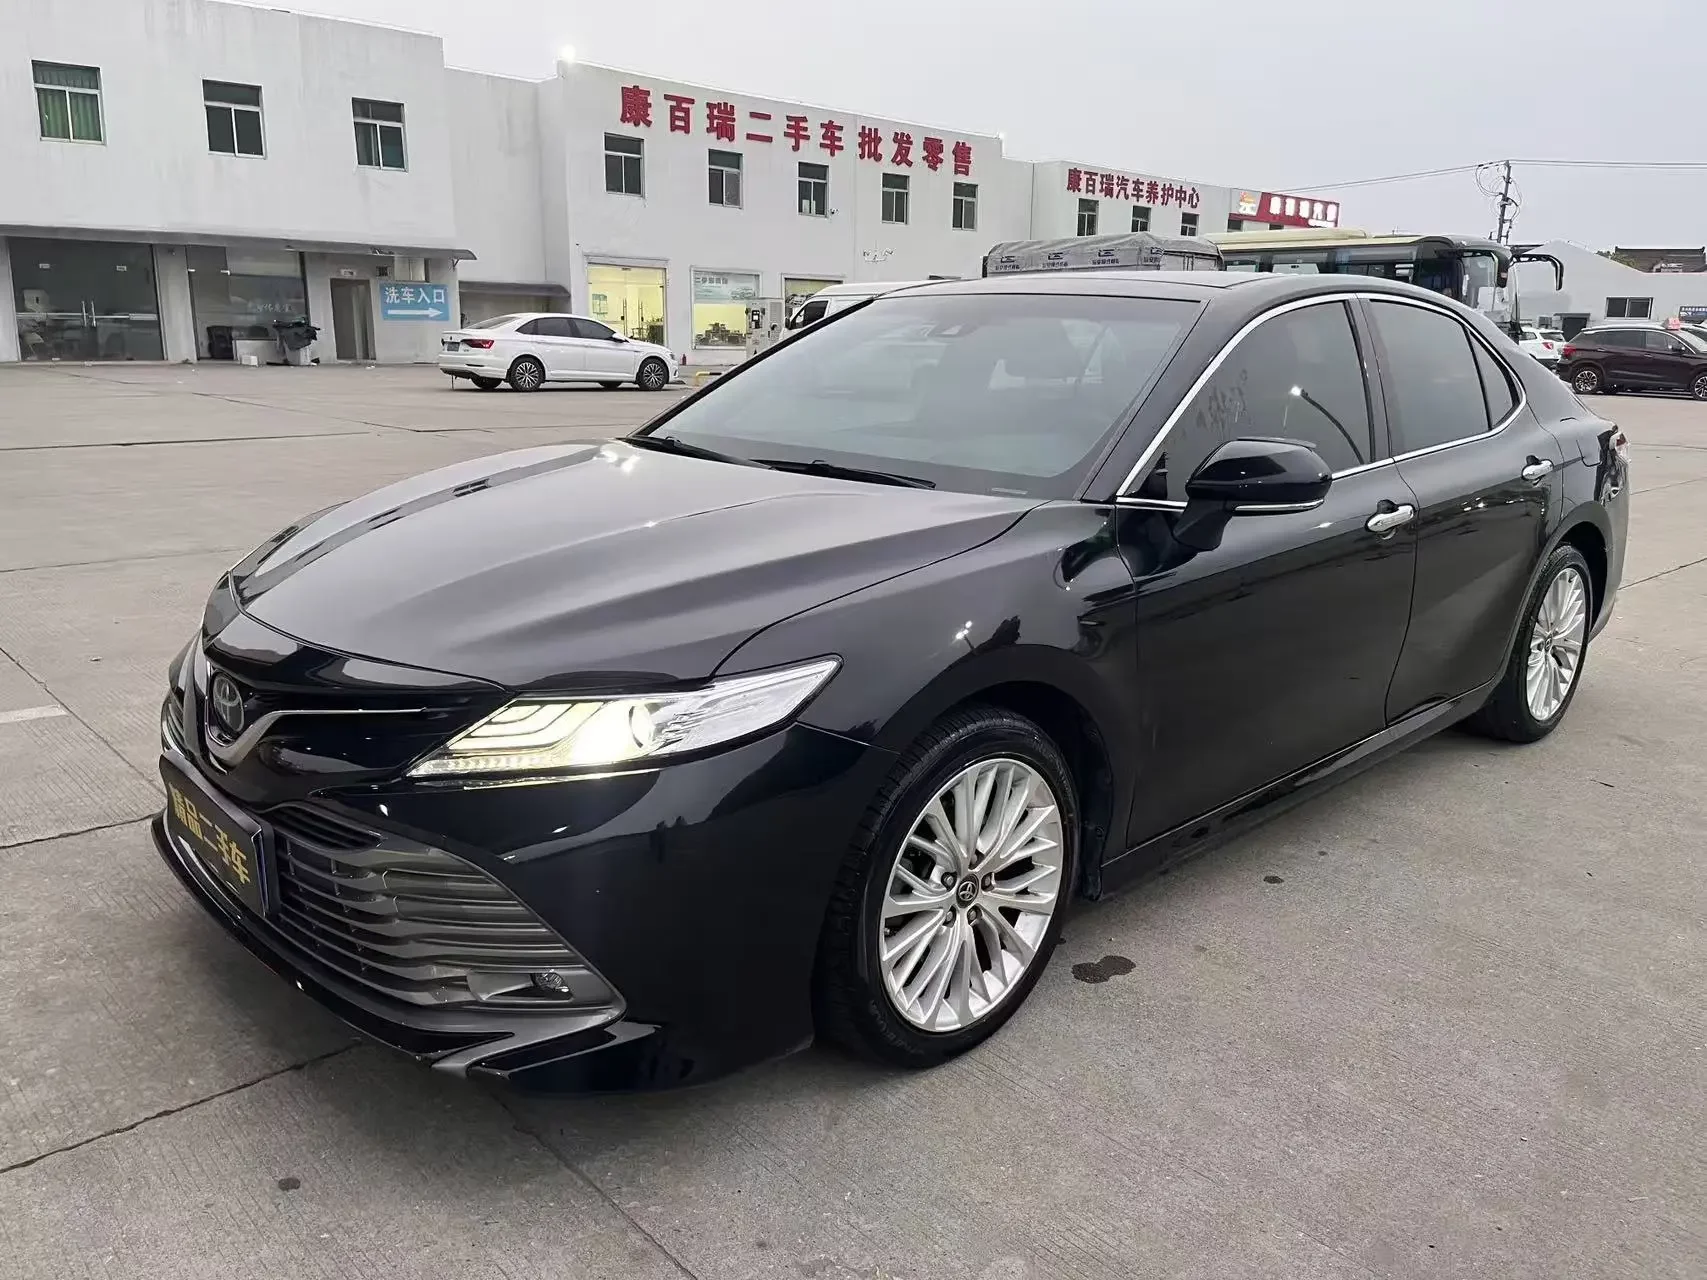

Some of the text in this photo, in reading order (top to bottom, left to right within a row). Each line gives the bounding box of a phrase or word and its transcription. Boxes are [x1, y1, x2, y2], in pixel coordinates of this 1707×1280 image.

[620, 85, 972, 176] 康百瑞二手车批发零售
[1067, 168, 1200, 208] 康百瑞汽车养护中心
[385, 286, 445, 304] 洗车入口
[169, 782, 250, 884] 精品二手车
